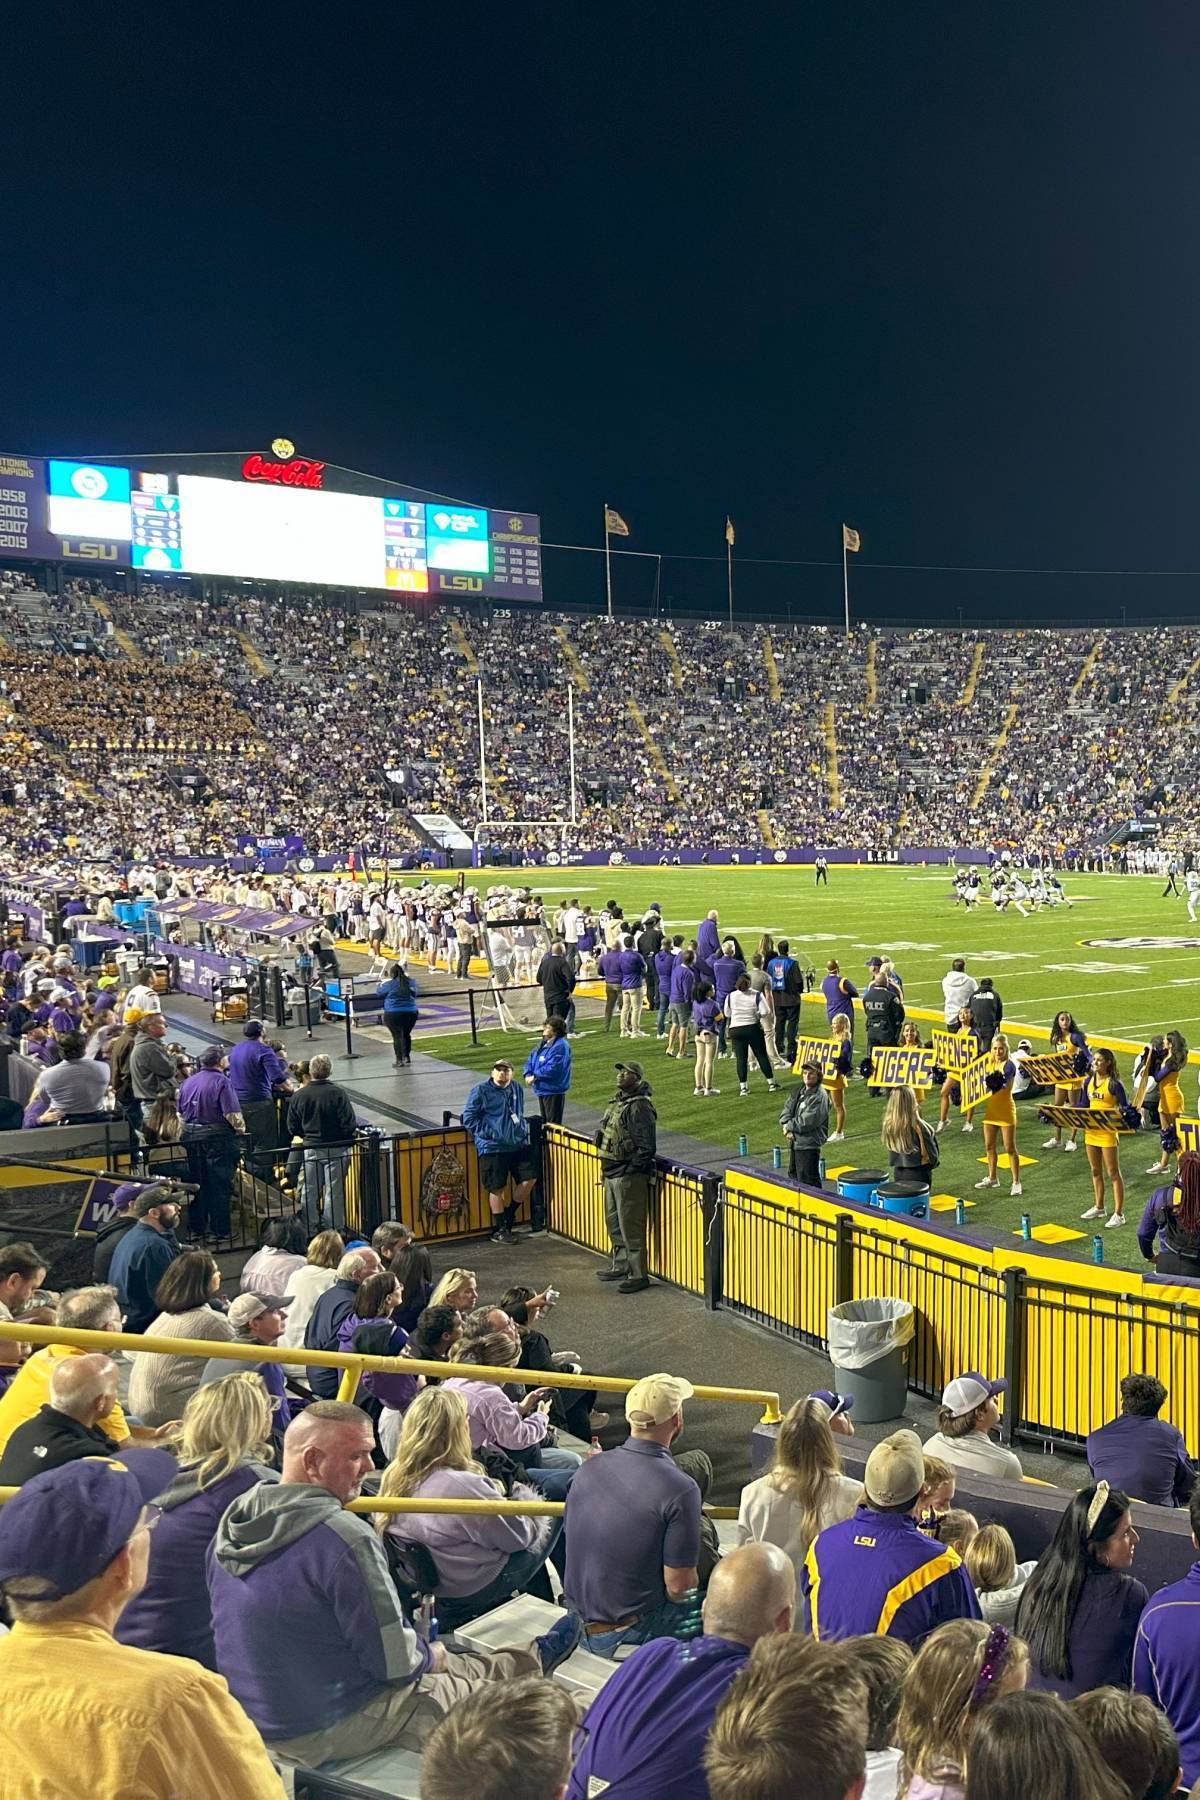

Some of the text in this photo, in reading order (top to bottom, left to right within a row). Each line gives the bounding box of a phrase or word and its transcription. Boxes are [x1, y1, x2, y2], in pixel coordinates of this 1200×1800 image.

[242, 455, 325, 488] Coca-Cola
[62, 540, 118, 561] LSU
[440, 575, 483, 592] LSU
[493, 609, 511, 619] 235
[865, 1001, 885, 1011] POLICE
[874, 1050, 934, 1085] TIGERS
[854, 1535, 877, 1547] LSU
